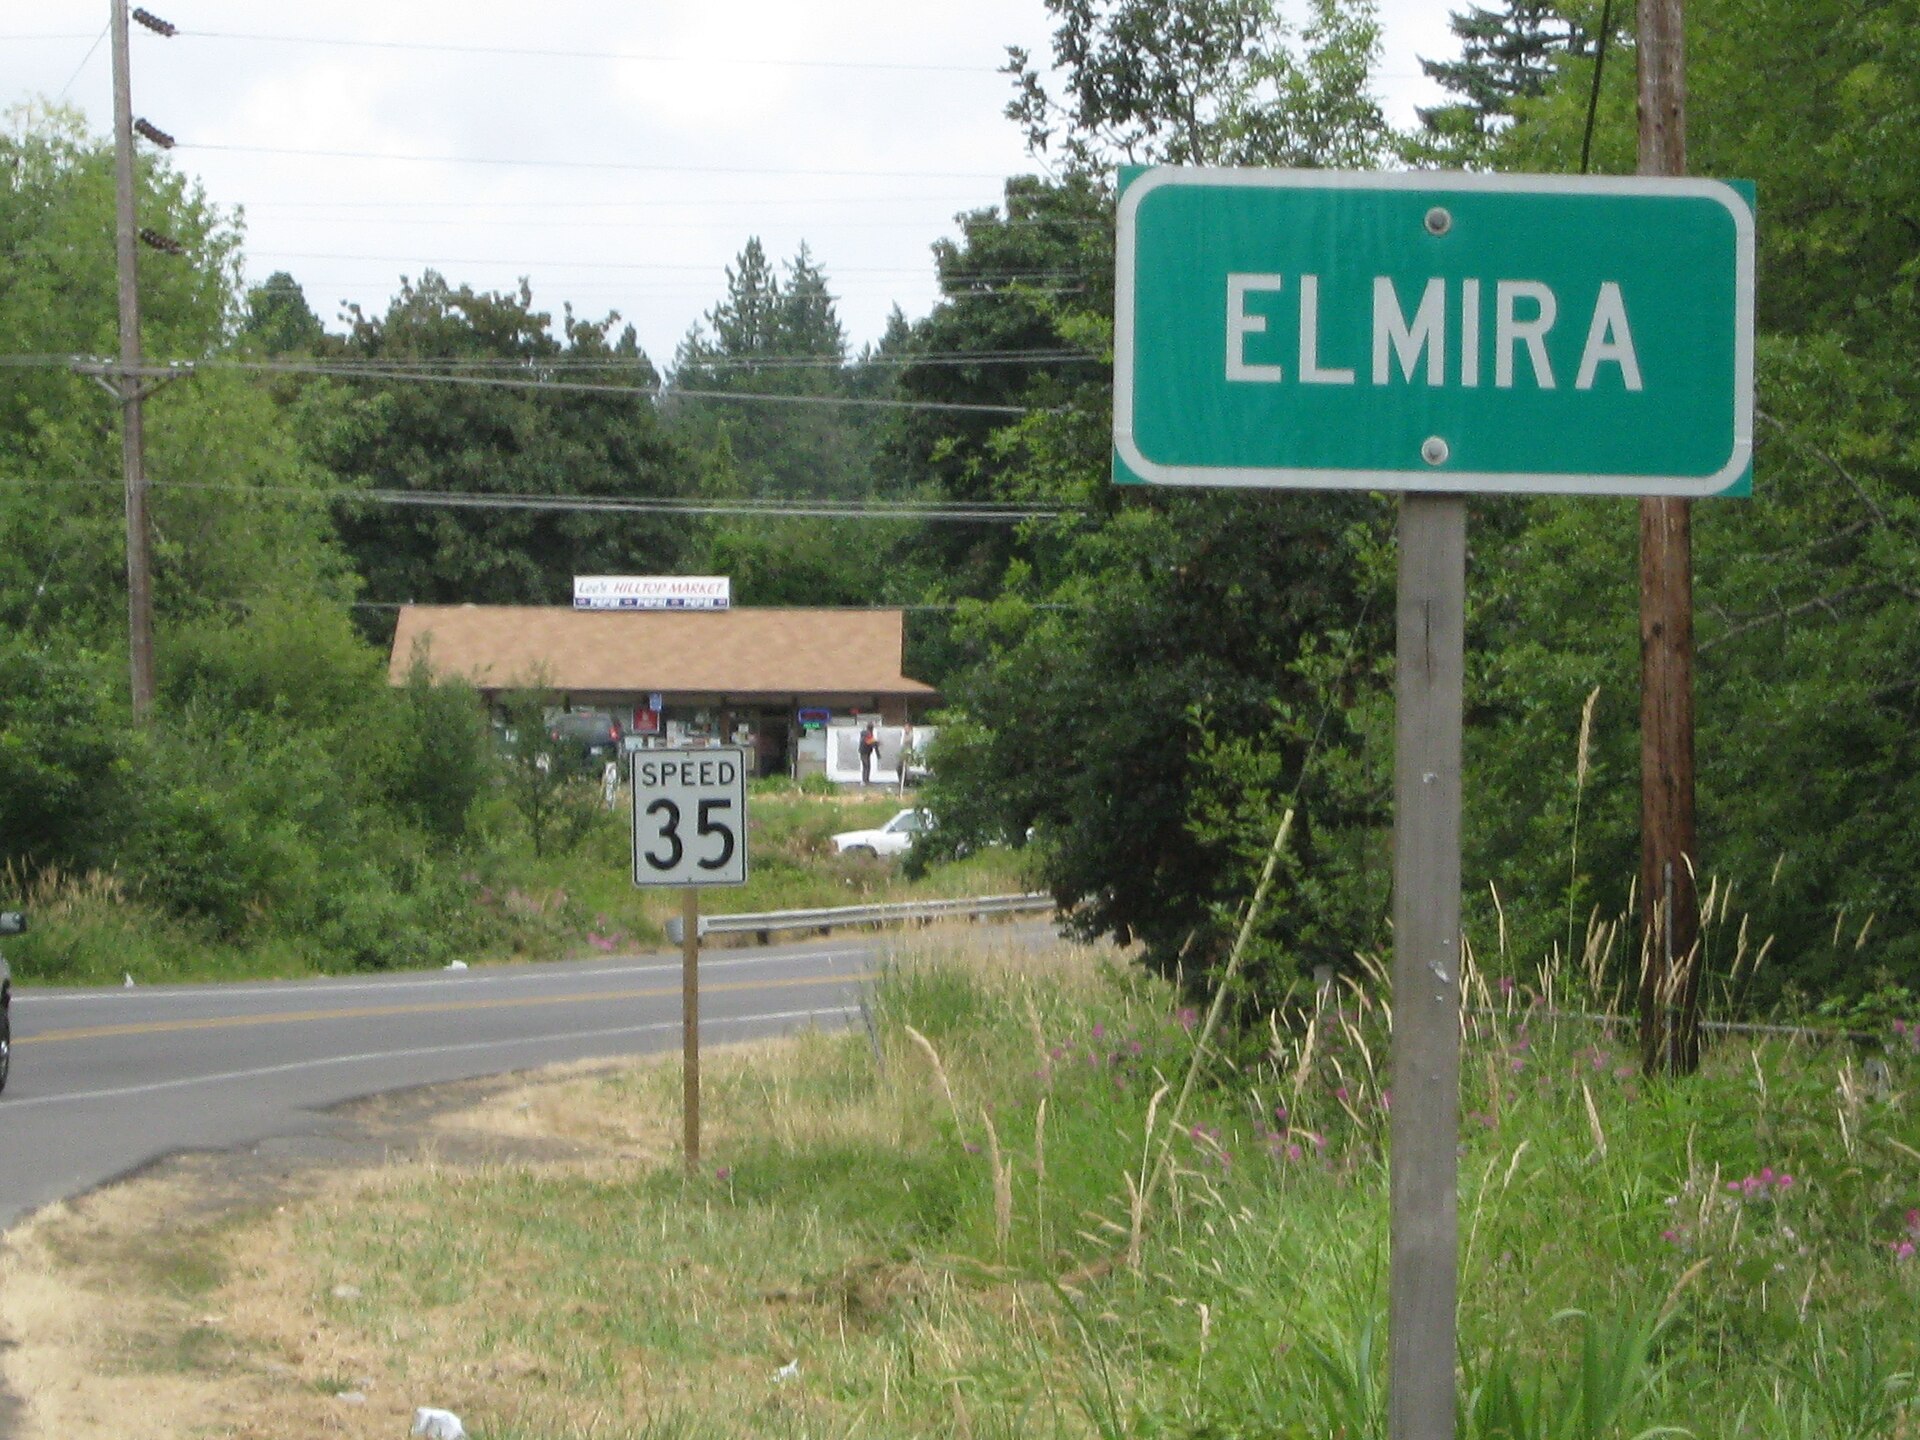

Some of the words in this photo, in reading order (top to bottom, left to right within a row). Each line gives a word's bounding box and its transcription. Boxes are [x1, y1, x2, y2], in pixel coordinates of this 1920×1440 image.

[1226, 273, 1643, 391] ELMIRA
[613, 581, 667, 594] HILLTOP
[669, 581, 724, 595] MARKET
[642, 761, 735, 786] SPEED
[644, 798, 735, 870] 35
